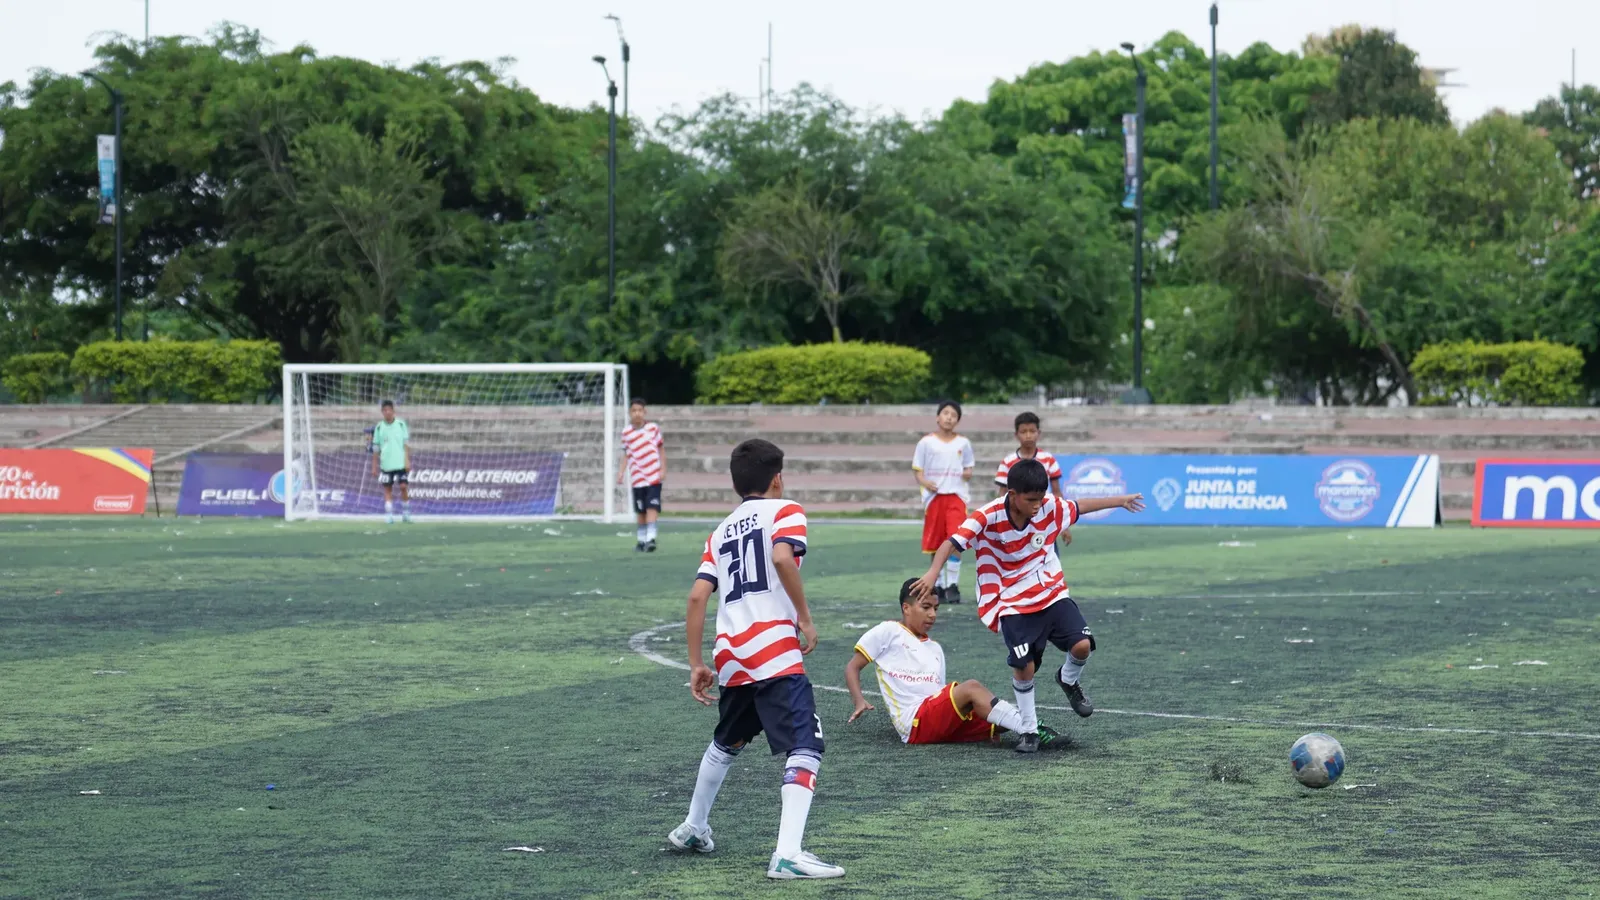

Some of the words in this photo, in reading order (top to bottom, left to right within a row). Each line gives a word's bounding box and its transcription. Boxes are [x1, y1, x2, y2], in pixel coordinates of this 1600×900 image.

[464, 470, 537, 483] EXTERIOR
[1185, 480, 1234, 494] JUNTA
[1236, 480, 1257, 494] DE
[1184, 494, 1288, 510] BENEFICENCIA
[719, 527, 771, 606] 30
